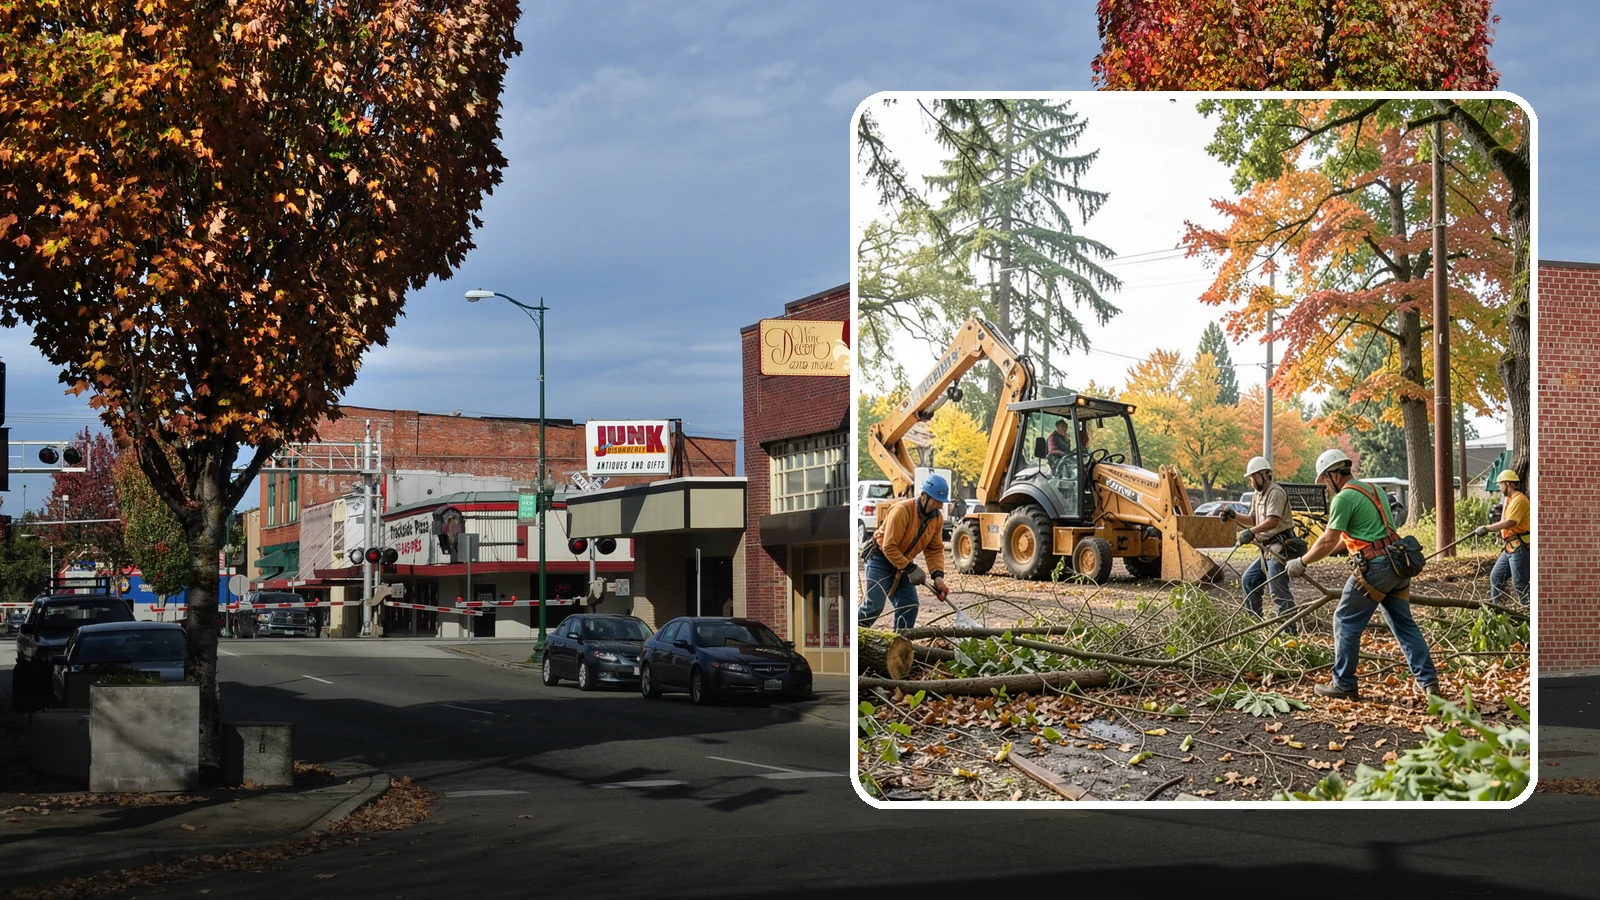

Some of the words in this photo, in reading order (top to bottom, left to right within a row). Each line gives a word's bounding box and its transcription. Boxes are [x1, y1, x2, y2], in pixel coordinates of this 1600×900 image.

[595, 425, 665, 457] JUNK
[596, 461, 628, 470] ANTIQUES
[631, 461, 644, 470] AND
[647, 460, 665, 469] GIFTS
[573, 473, 589, 492] RAIL
[390, 522, 413, 539] Trackside
[414, 519, 429, 535] Pizza
